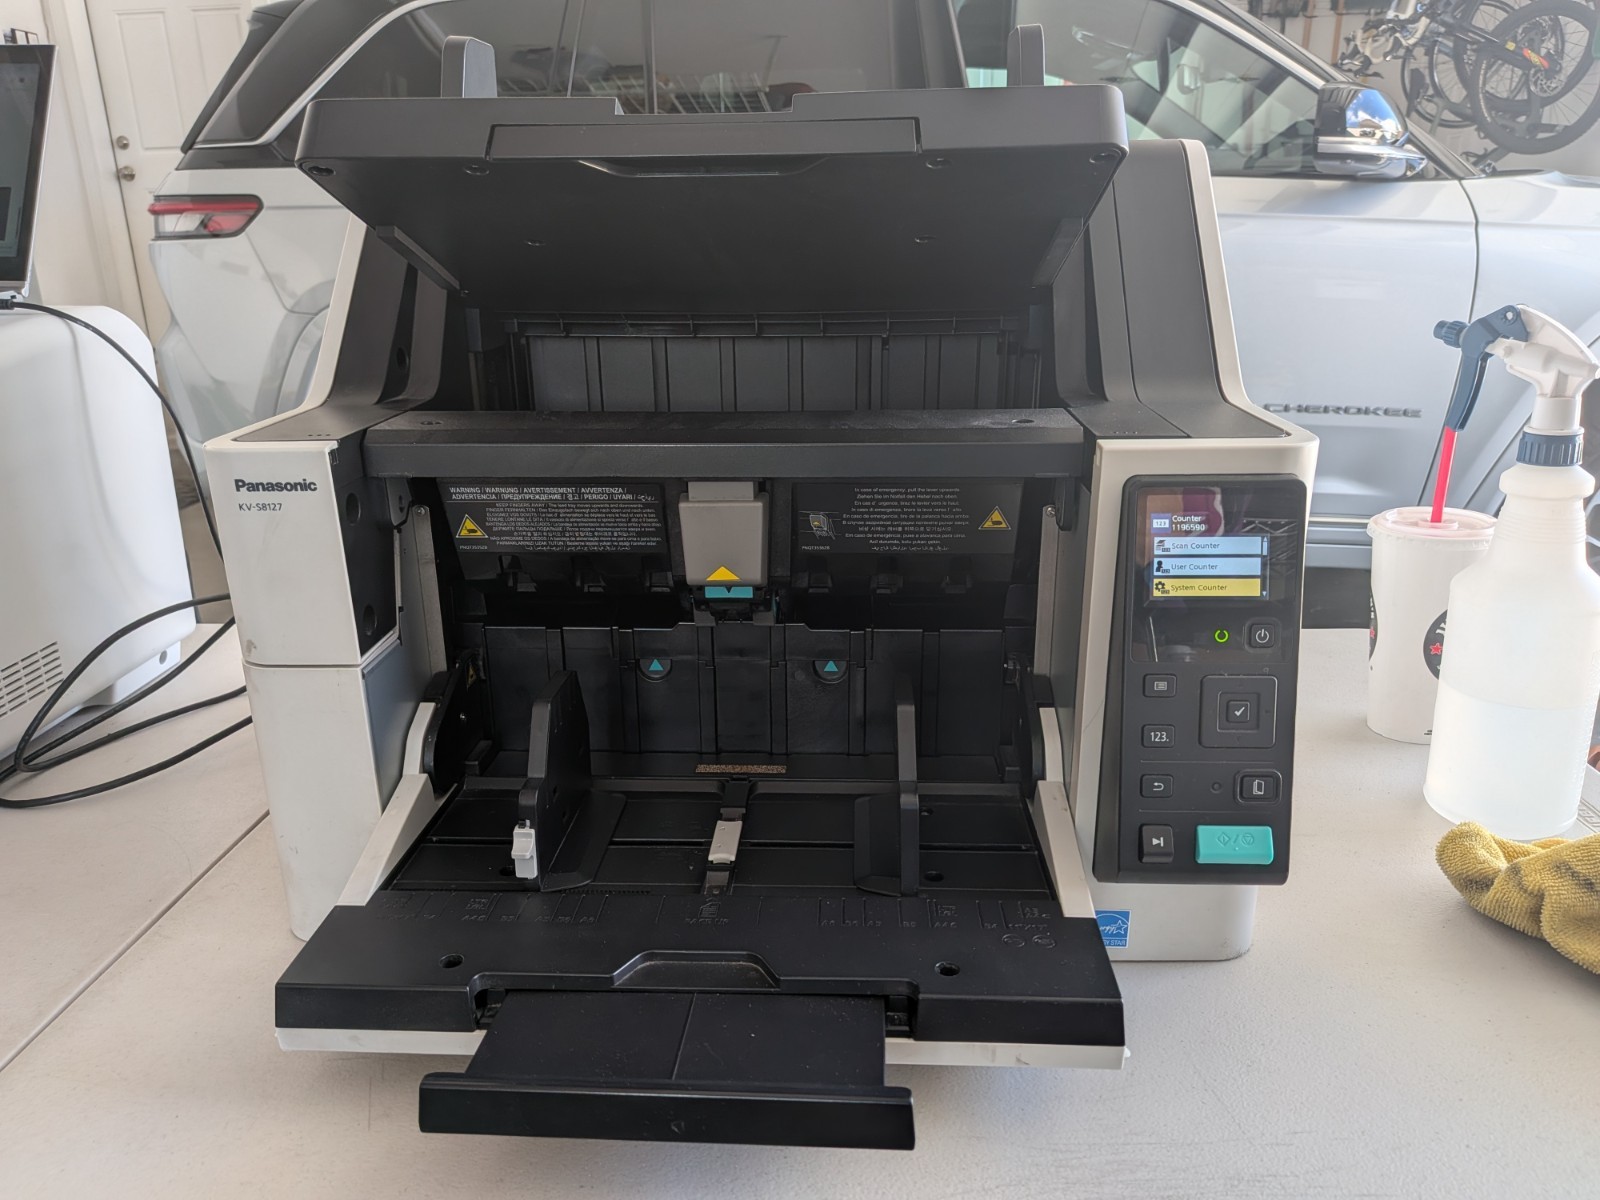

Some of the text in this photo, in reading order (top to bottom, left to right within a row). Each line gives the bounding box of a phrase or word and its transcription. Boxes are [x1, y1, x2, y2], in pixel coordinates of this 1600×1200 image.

[1263, 403, 1422, 418] CHEROKEE
[234, 478, 318, 492] Panasonic
[238, 503, 282, 511] KV-S8127
[1172, 523, 1206, 531] 1196590
[1150, 732, 1170, 742] 123.
